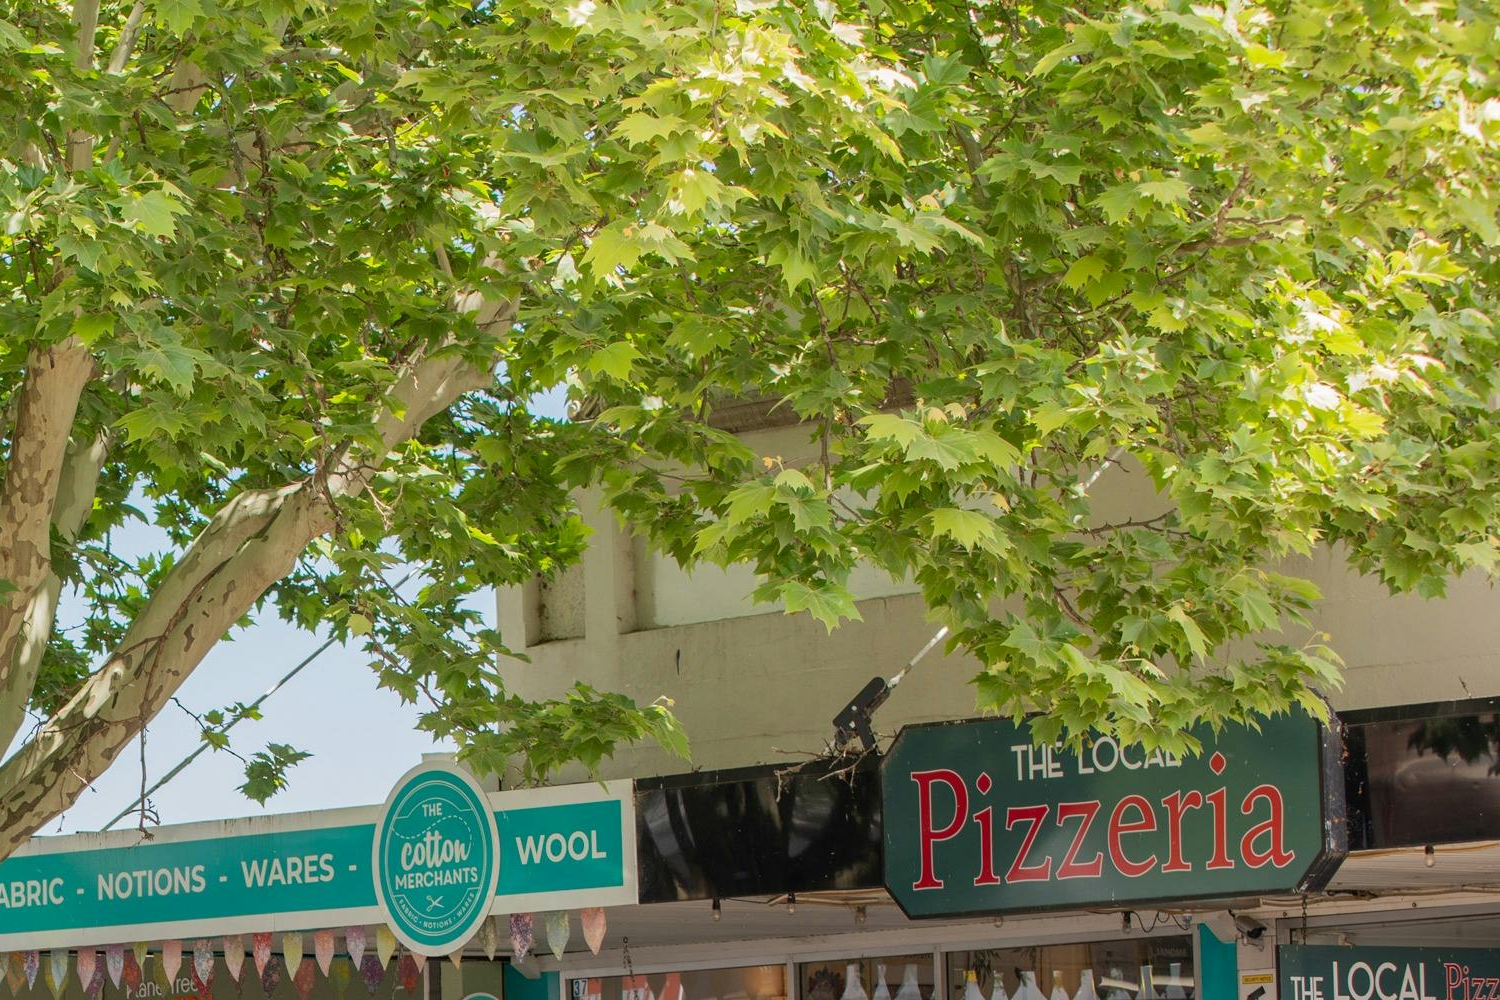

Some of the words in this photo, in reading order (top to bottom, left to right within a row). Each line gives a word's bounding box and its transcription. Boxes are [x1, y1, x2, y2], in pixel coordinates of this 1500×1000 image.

[1011, 741, 1064, 781] THE
[421, 802, 443, 818] THE
[910, 751, 1295, 891] Pizzeria
[98, 864, 207, 901] NOTIONS
[241, 852, 335, 888] WARES
[515, 829, 607, 865] WOOL
[400, 830, 470, 871] cotton
[394, 866, 479, 890] MERCHANTS
[573, 980, 587, 997] 37
